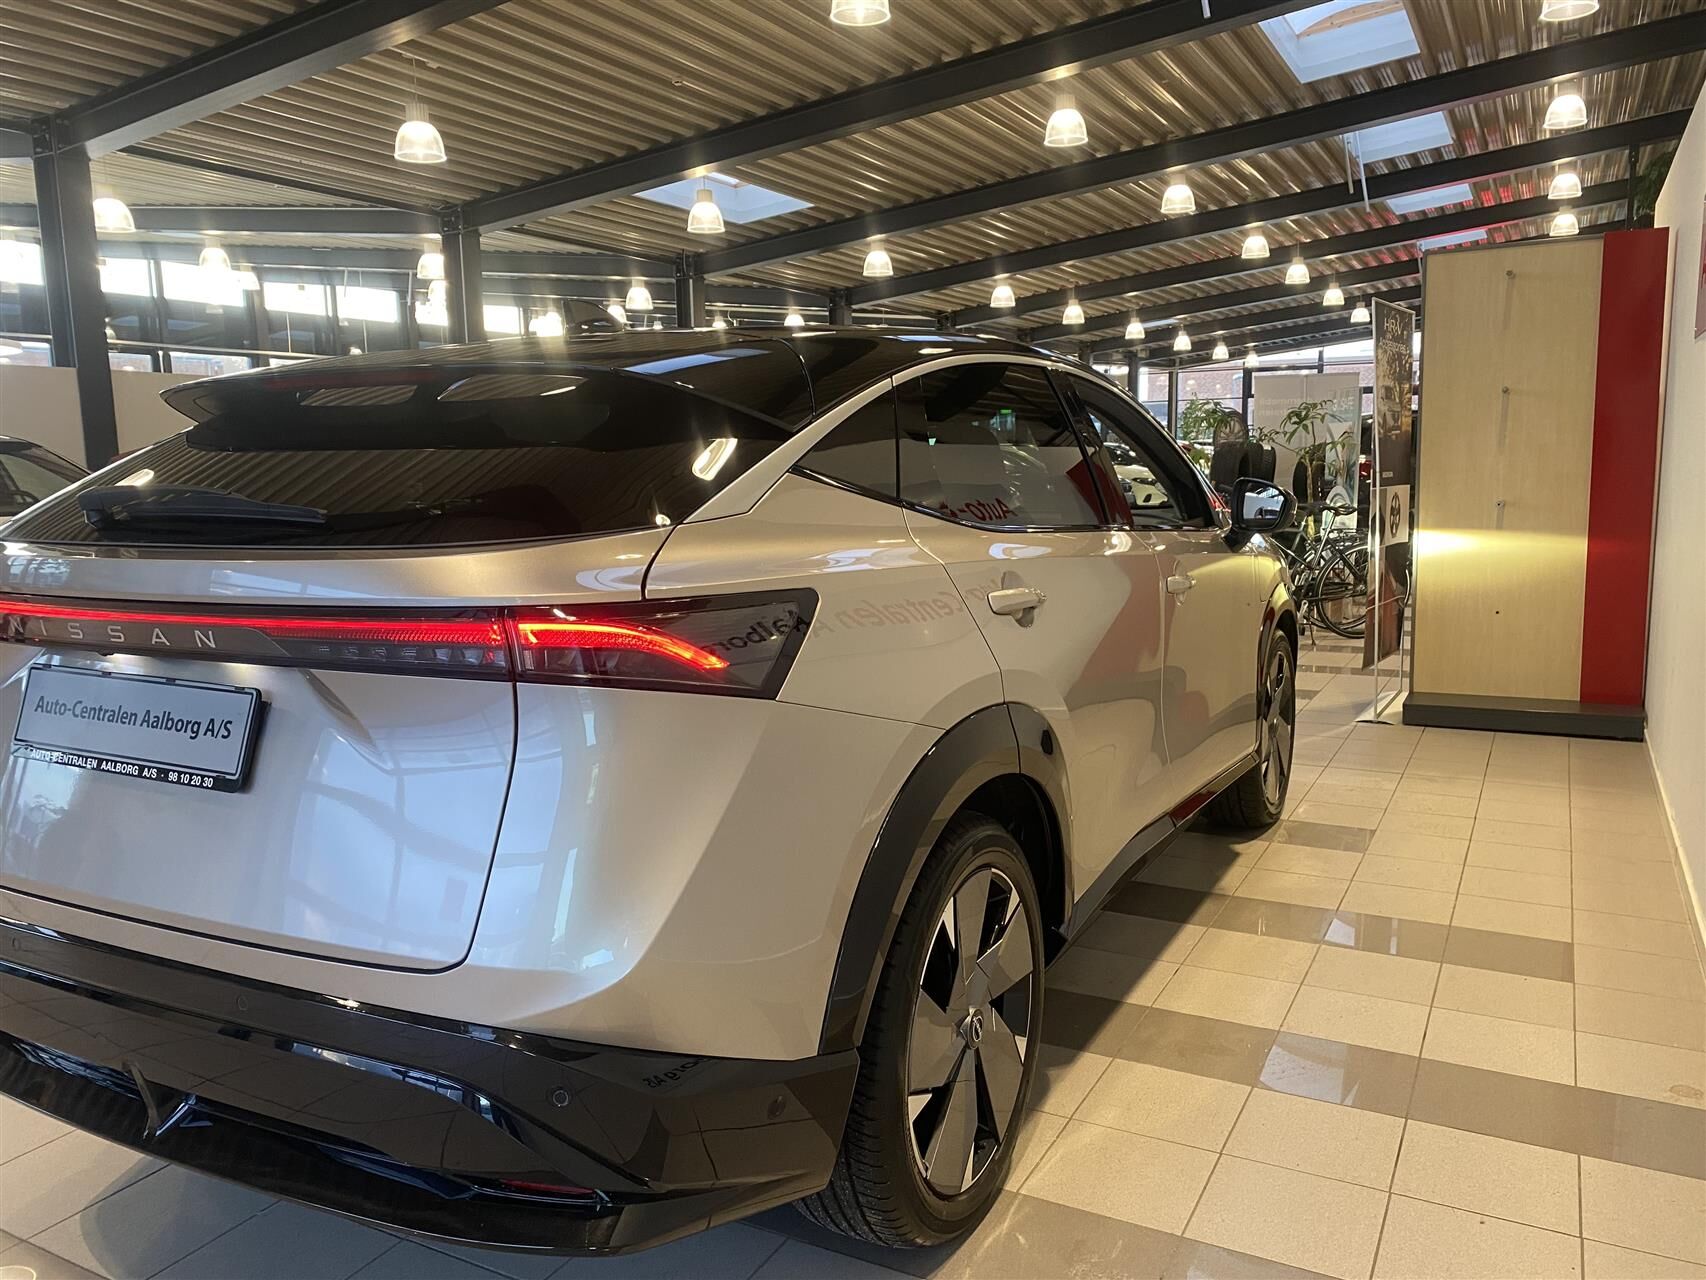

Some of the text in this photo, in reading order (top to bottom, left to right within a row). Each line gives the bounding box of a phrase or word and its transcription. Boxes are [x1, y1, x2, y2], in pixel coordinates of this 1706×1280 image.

[8, 614, 216, 649] NISSAN
[34, 695, 233, 740] Auto-Centralen Aalborg A/S
[30, 749, 98, 769] AUTO-CENTRALEN
[100, 760, 139, 776] AALBORG
[142, 767, 158, 779] A/S
[168, 771, 178, 782] 98
[180, 773, 190, 784] 10
[191, 775, 202, 786] 20
[202, 777, 214, 788] 30
